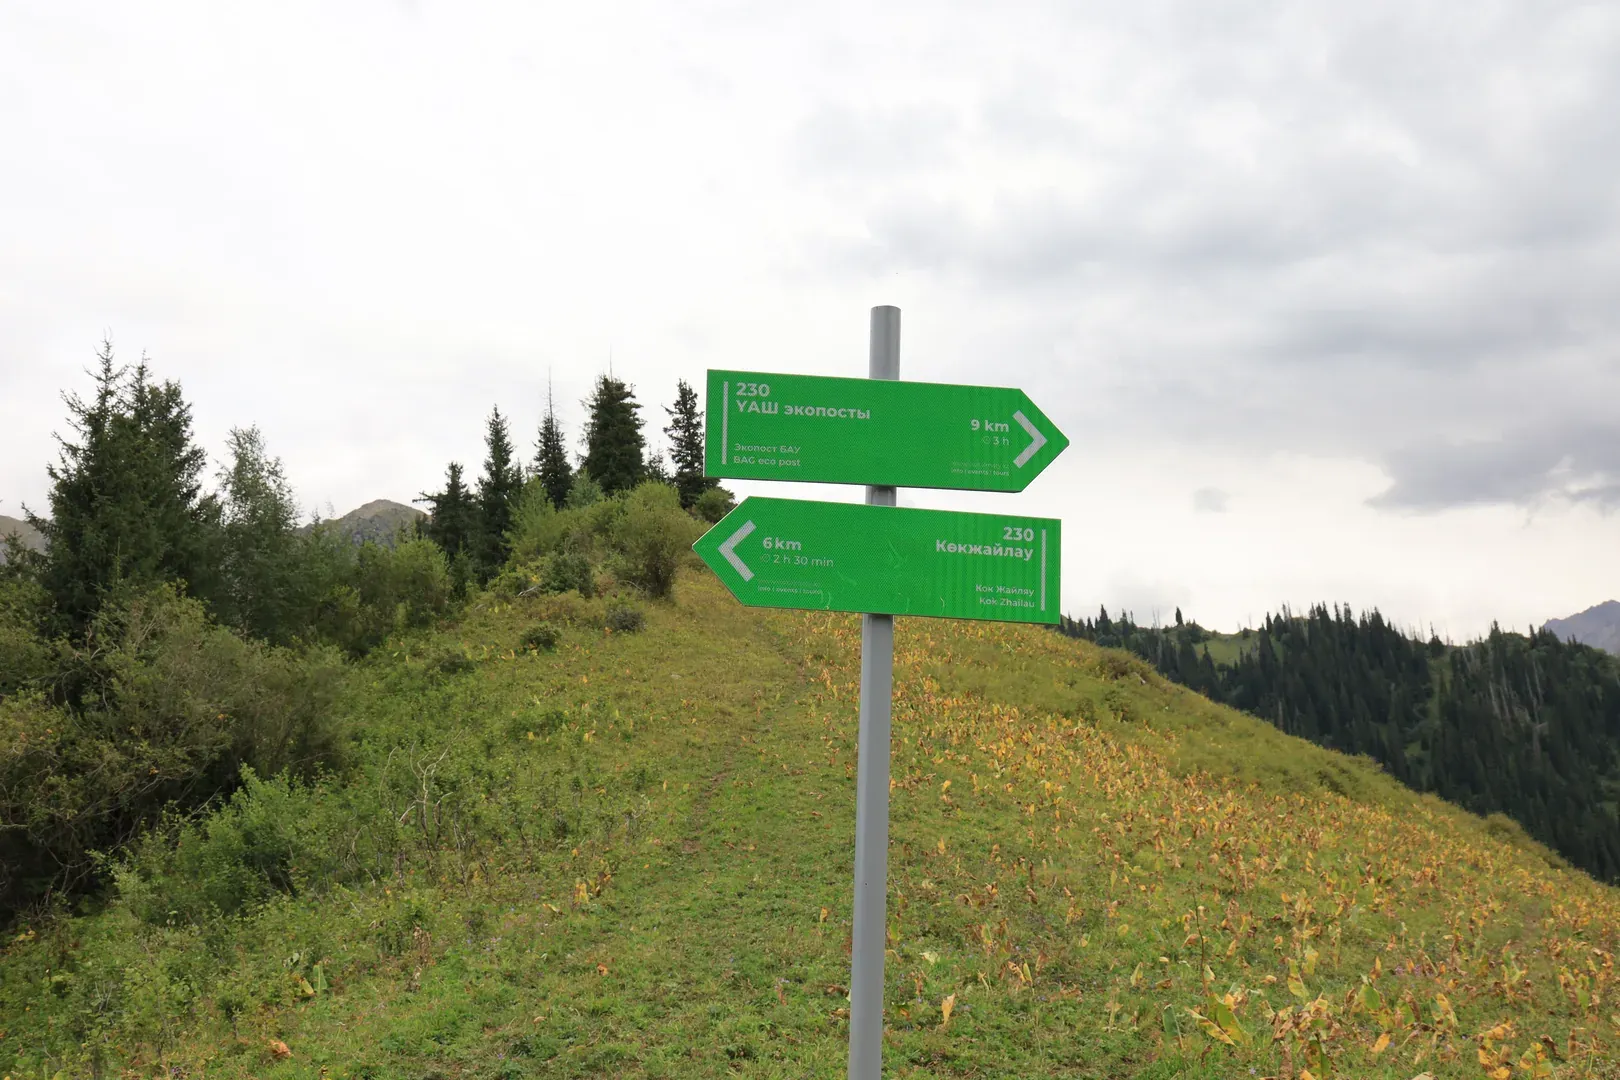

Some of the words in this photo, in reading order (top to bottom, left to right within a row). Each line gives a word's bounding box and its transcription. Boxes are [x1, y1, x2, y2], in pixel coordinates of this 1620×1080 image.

[736, 382, 771, 397] 230
[784, 404, 871, 420] экопосты
[970, 419, 980, 431] 9
[985, 419, 1010, 433] km
[992, 436, 1000, 446] 3
[1002, 437, 1010, 446] h
[734, 443, 777, 453] Экопост
[780, 445, 800, 454] БАУ
[758, 458, 776, 466] eco
[779, 459, 801, 468] post
[1003, 526, 1035, 542] 230
[762, 537, 773, 549] 6
[775, 537, 802, 551] km
[935, 539, 1034, 561] Көкжайлау
[773, 554, 780, 564] 2
[783, 555, 791, 565] h
[794, 556, 808, 566] 30
[811, 557, 834, 567] min
[975, 584, 994, 593] Кок
[980, 597, 997, 605] Kok
[1000, 597, 1035, 608] Zhailau
